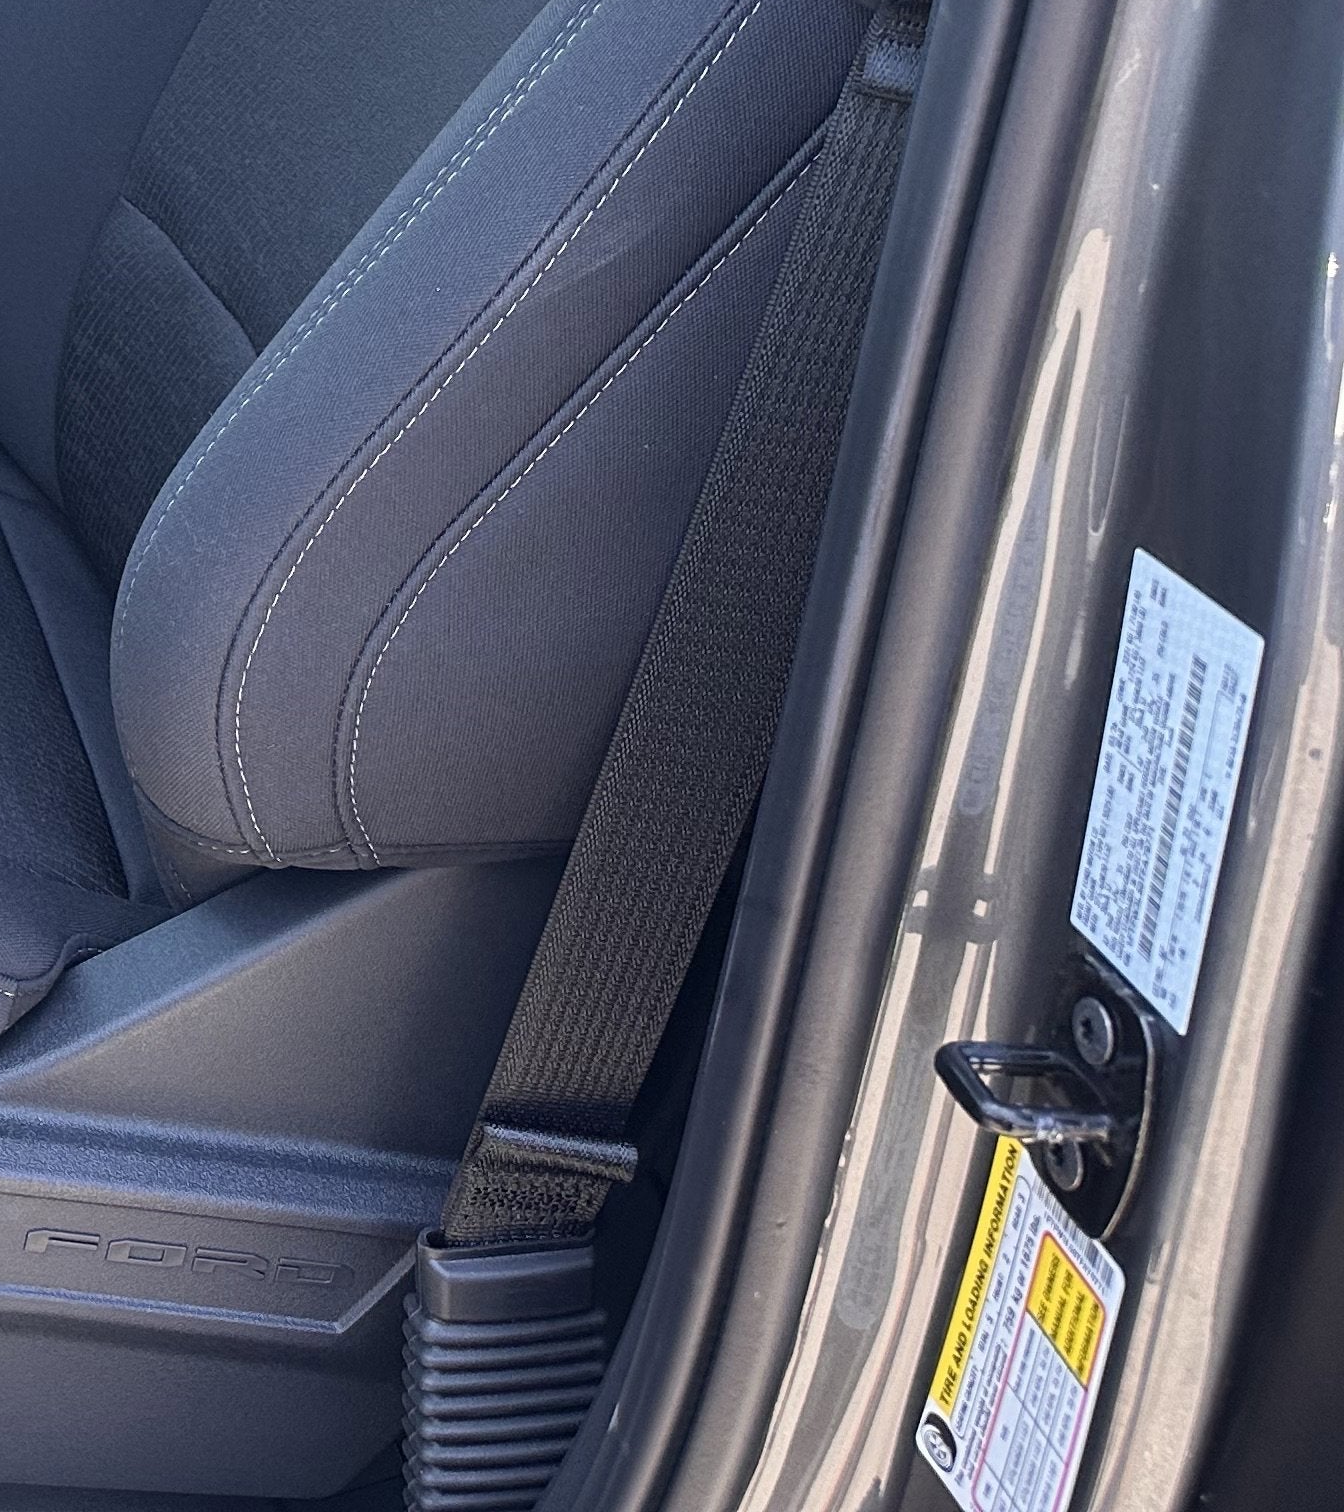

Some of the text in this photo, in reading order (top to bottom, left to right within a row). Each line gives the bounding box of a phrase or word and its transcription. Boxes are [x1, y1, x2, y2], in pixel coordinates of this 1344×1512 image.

[23, 1227, 355, 1285] FORD
[939, 1369, 960, 1407] TIRE
[952, 1330, 969, 1369] AND
[962, 1261, 989, 1332] LOADING
[982, 1142, 1019, 1258] INFORMATION
